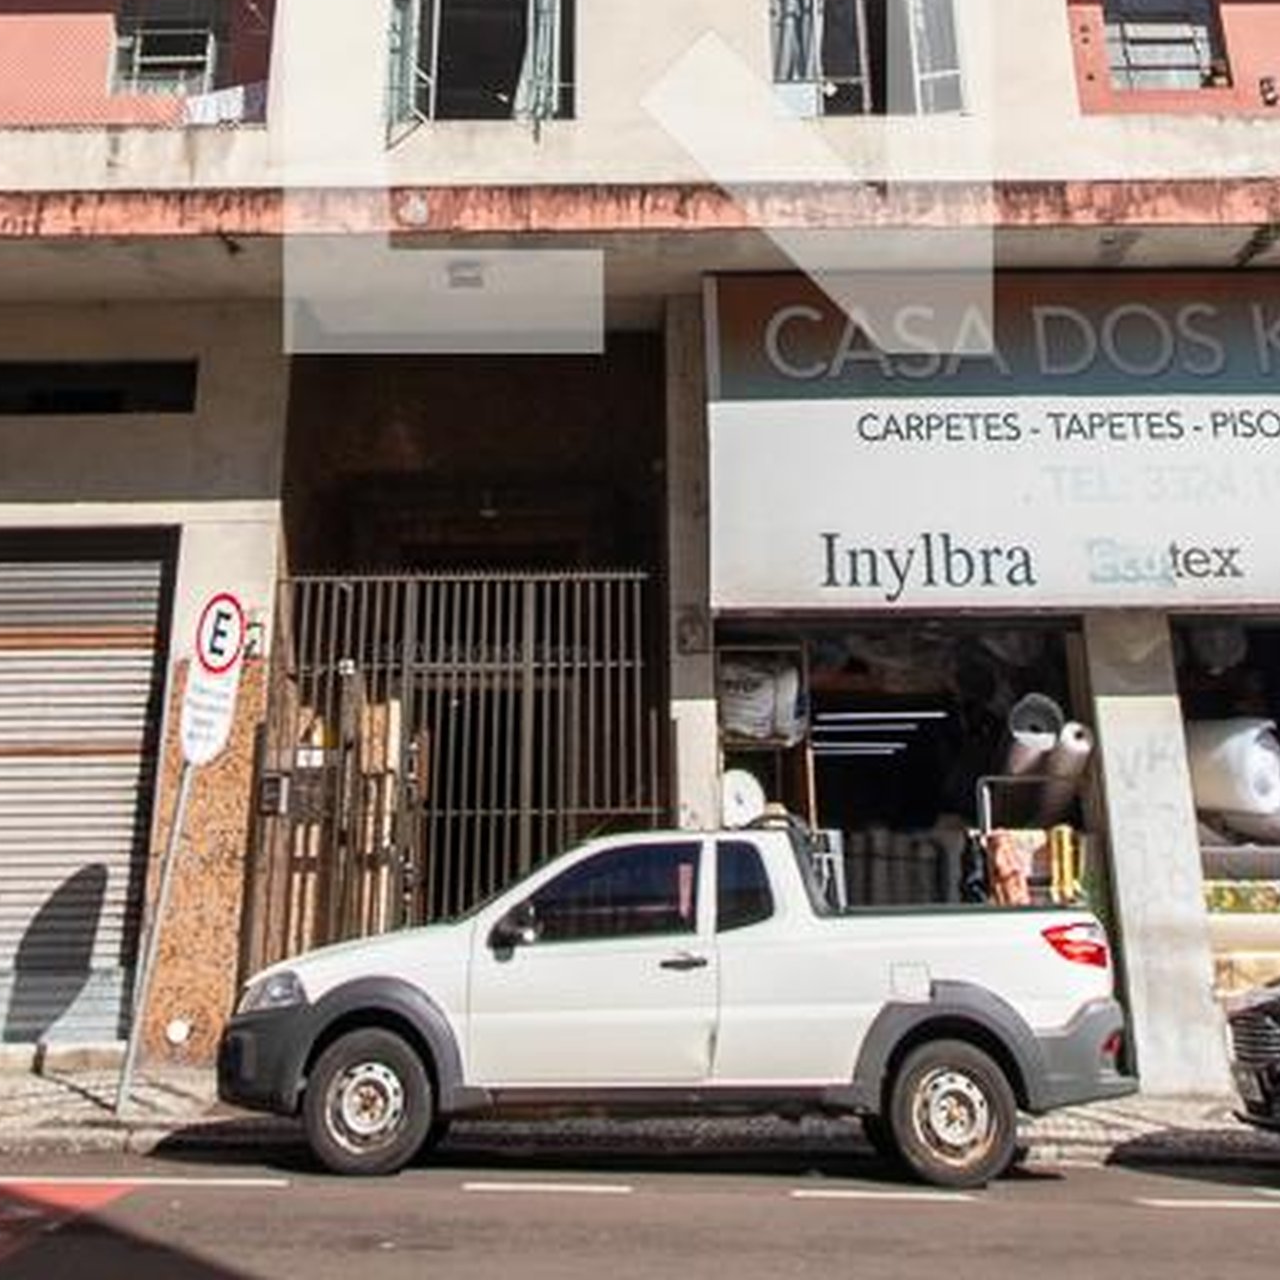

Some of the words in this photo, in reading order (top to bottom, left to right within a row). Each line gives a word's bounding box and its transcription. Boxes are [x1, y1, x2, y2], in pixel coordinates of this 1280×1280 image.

[765, 304, 1011, 379] CASA
[1032, 302, 1224, 377] DOS
[857, 413, 1021, 443] CARPETES
[1049, 411, 1184, 441] TAPETES
[819, 532, 1037, 601] Inylbra
[208, 609, 232, 657] E
